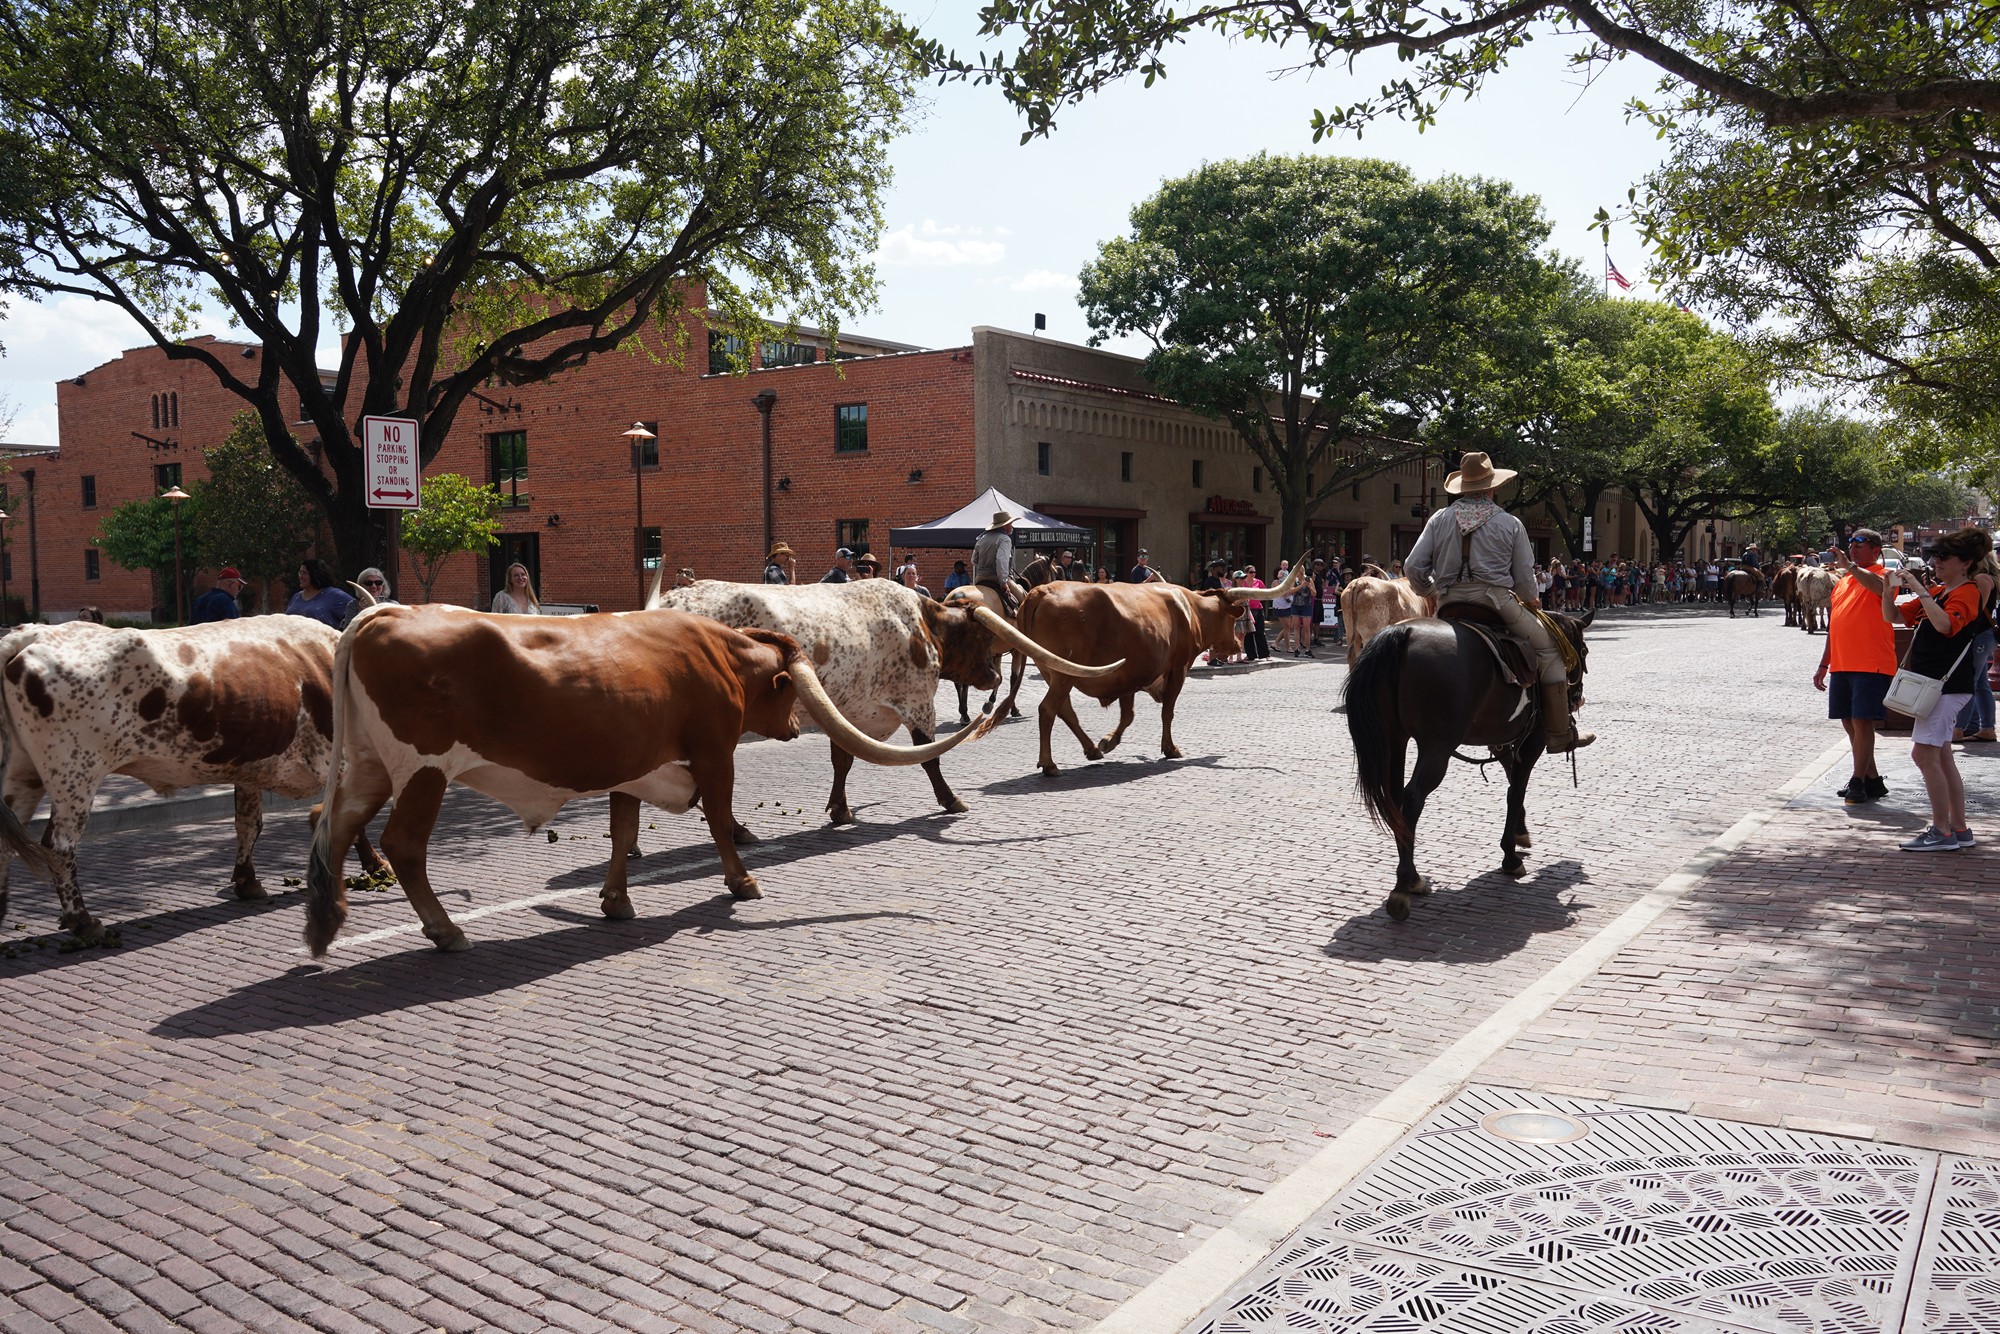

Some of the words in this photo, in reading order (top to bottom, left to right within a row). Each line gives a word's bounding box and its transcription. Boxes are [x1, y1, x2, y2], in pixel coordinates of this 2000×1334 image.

[383, 425, 400, 443] NO
[378, 443, 407, 454] PARKING
[376, 454, 409, 465] STOPPING
[388, 465, 397, 475] OR
[377, 475, 410, 486] STANDING
[1029, 532, 1040, 542] FORT
[1040, 532, 1055, 542] WORTH
[1056, 532, 1080, 543] STOCKYARDS
